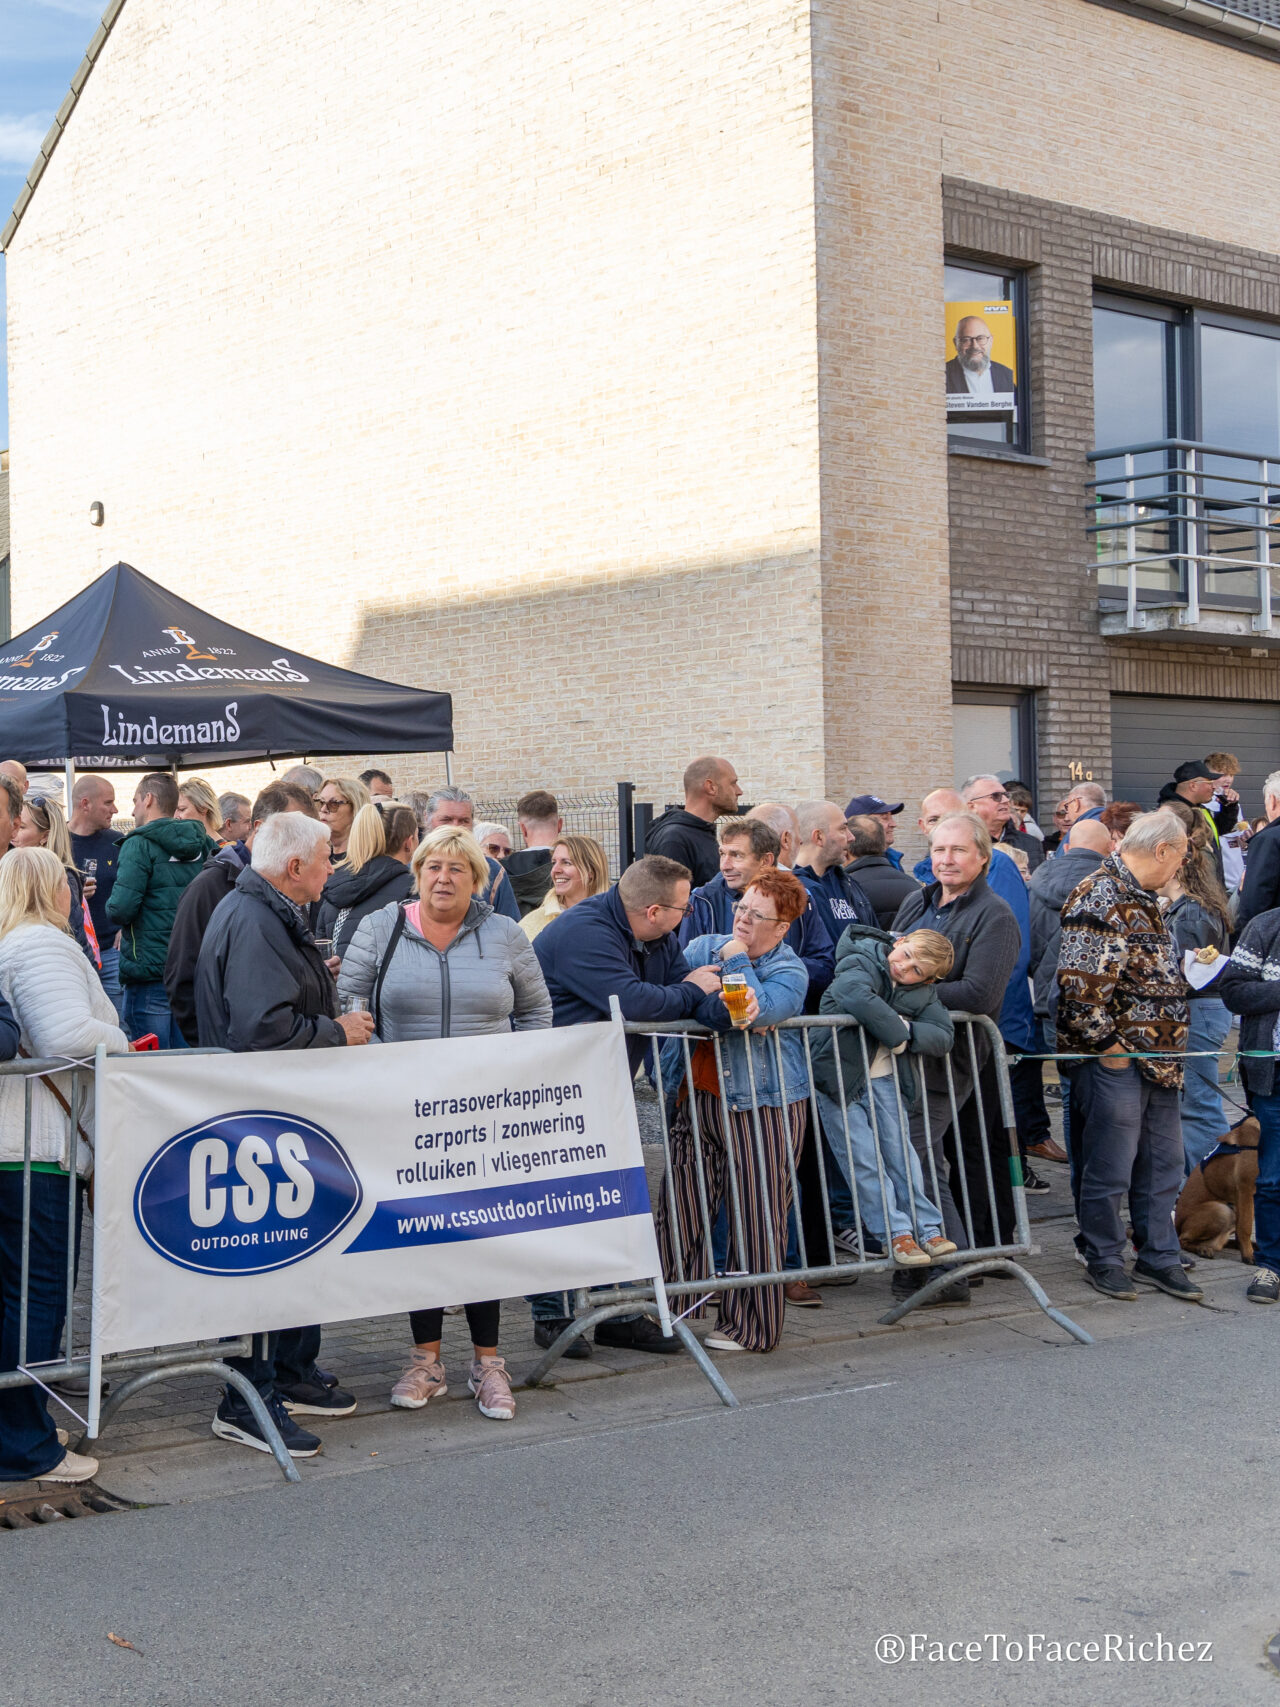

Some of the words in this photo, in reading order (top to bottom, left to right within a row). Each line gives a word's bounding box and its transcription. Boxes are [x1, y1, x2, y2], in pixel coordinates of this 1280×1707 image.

[39, 653, 66, 662] 1822
[142, 646, 181, 658] ANNO
[207, 646, 237, 656] 1822
[414, 1081, 583, 1119] terrasoverkappingen
[414, 1123, 488, 1153] carports
[502, 1111, 586, 1141] zonwering
[188, 1131, 316, 1228] CSS
[396, 1155, 478, 1185] rolluiken
[491, 1141, 607, 1175] vliegenramen
[397, 1187, 622, 1235] www.cssoutdoorliving.be
[191, 1232, 260, 1252] OUTDOOR
[264, 1227, 309, 1244] LIVING
